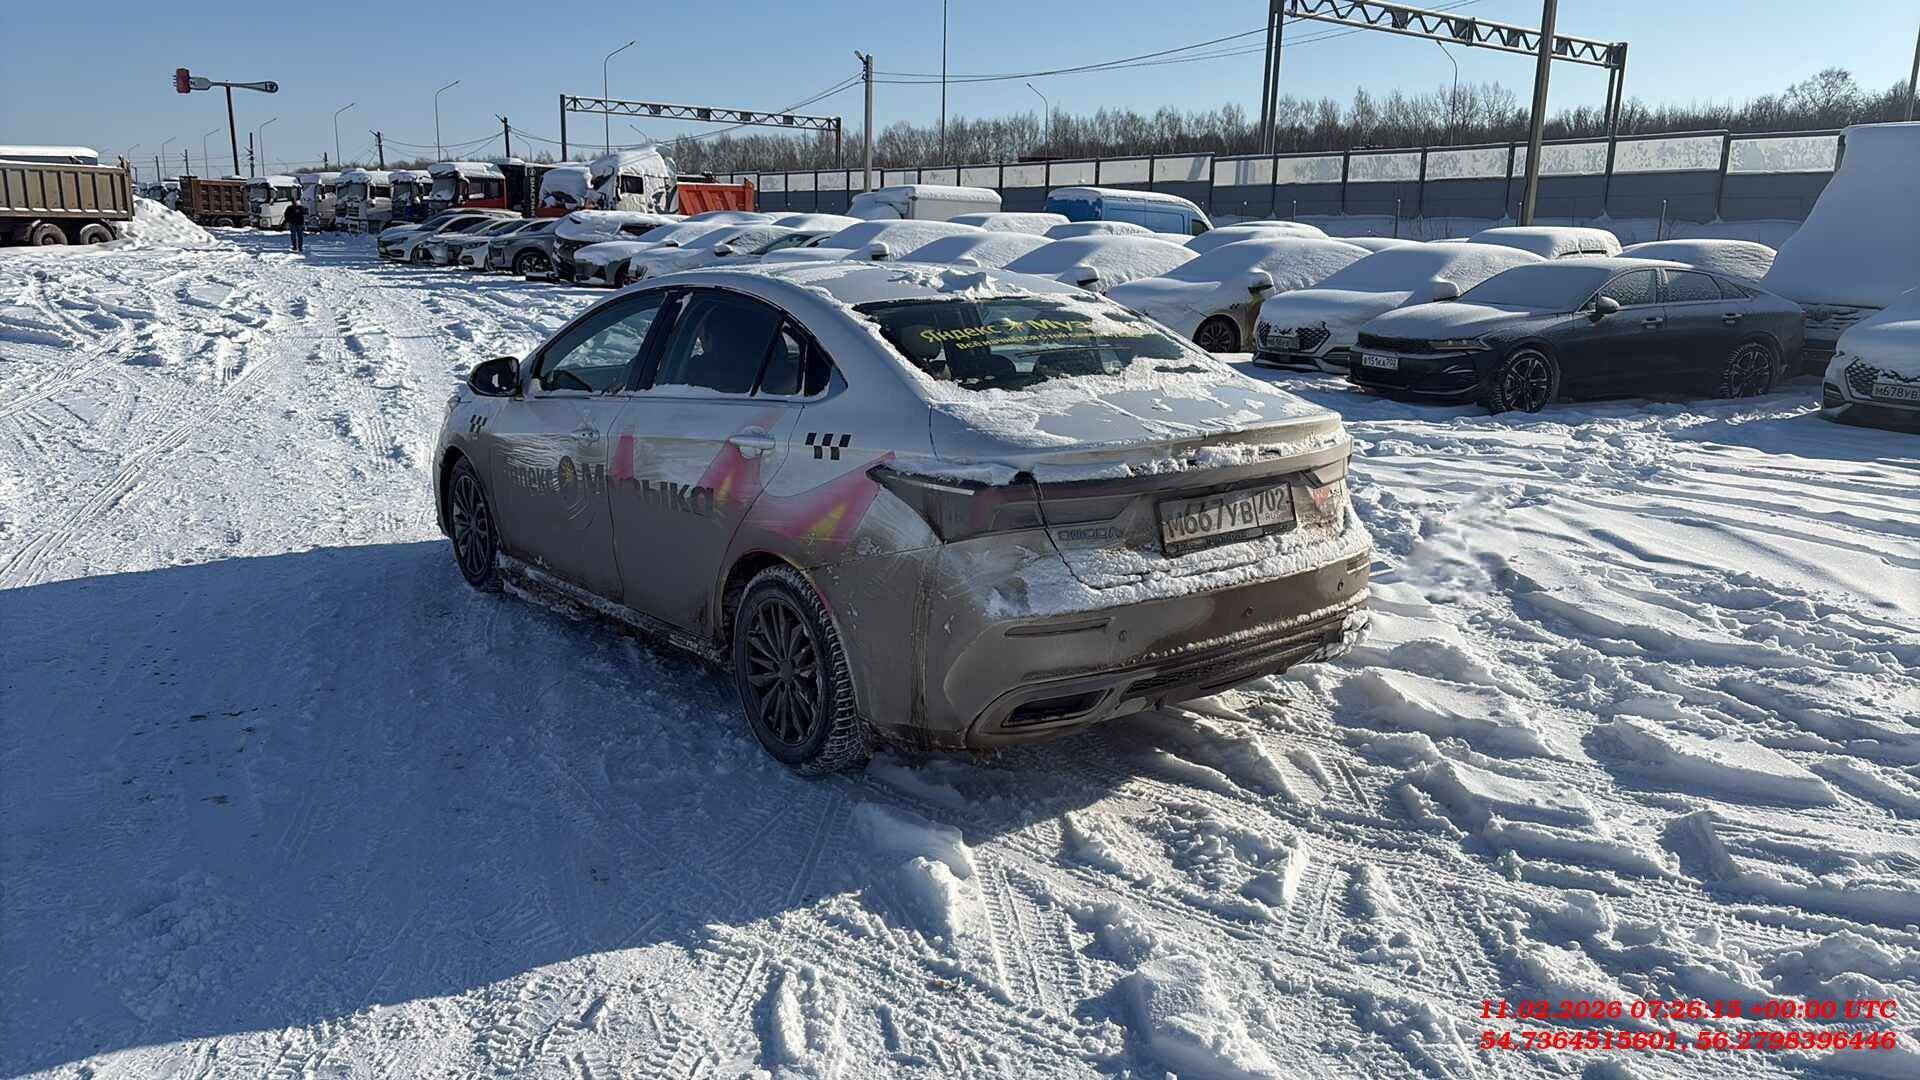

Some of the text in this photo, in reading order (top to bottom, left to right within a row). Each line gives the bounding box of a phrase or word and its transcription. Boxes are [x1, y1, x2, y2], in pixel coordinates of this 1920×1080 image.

[920, 325, 1001, 343] Яндекс
[1165, 487, 1284, 538] М667УВ 702
